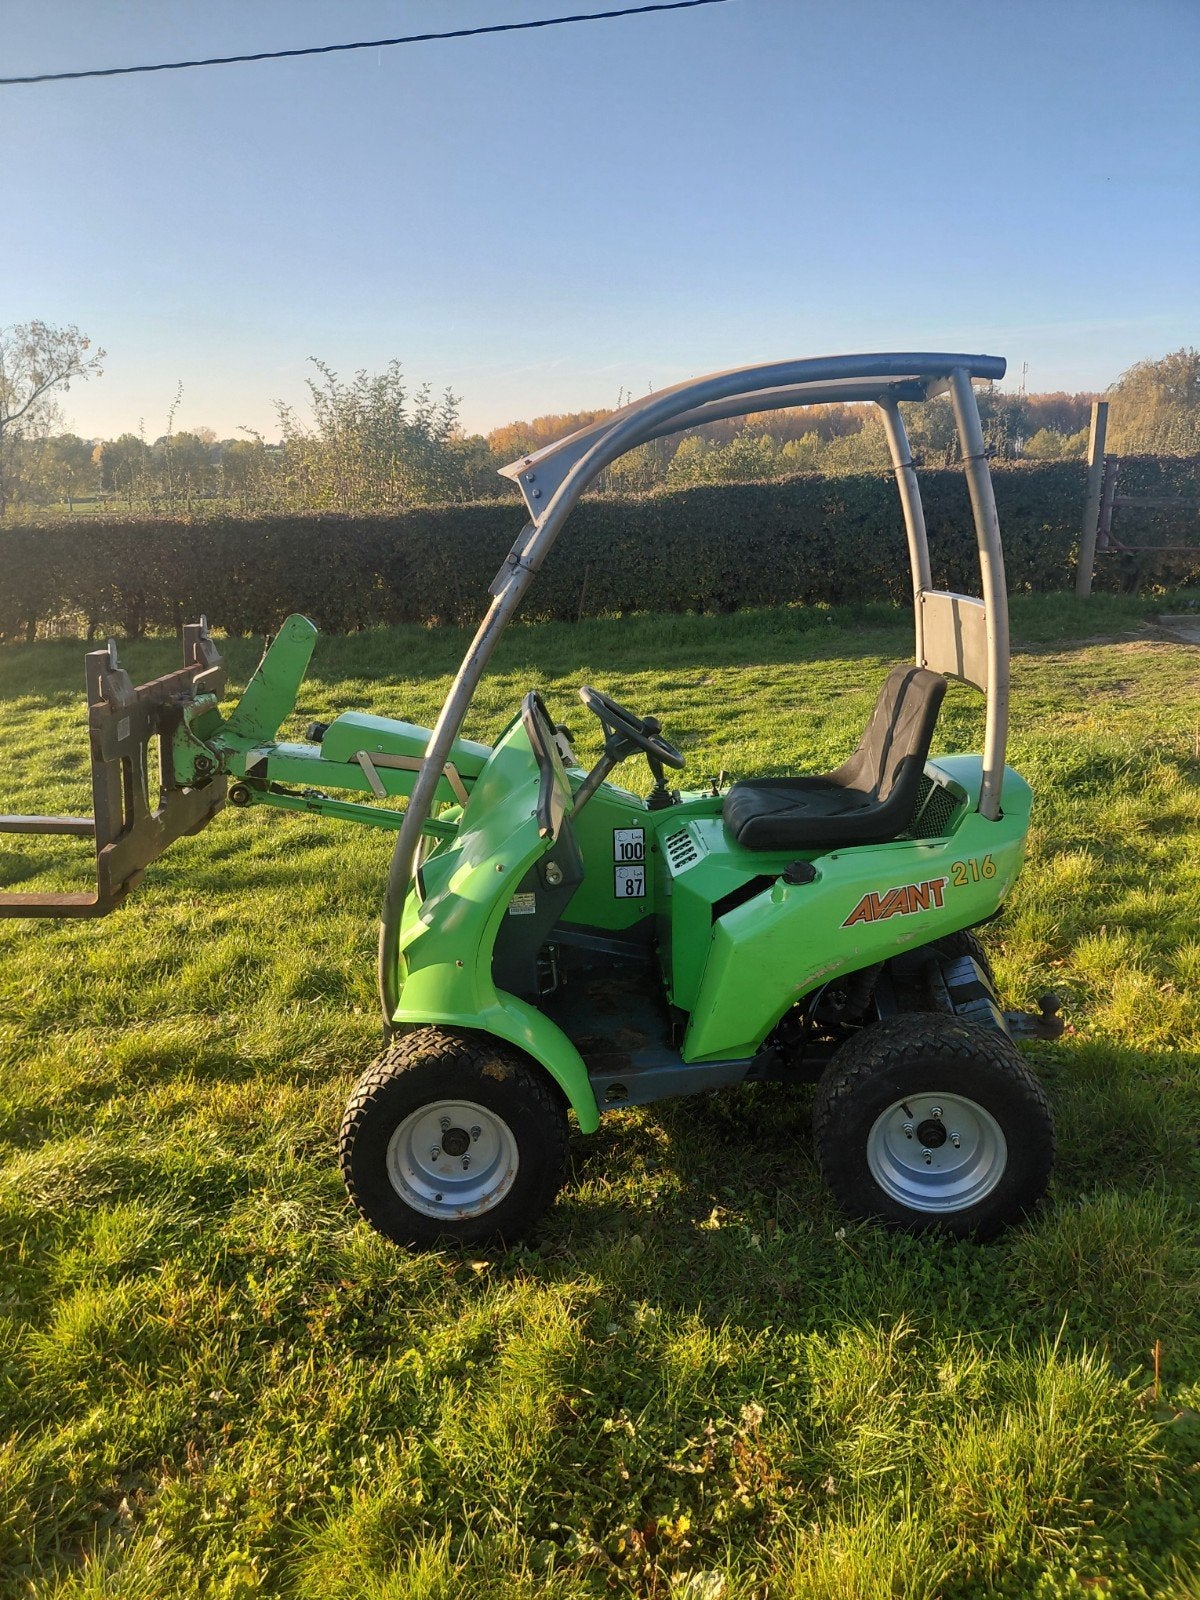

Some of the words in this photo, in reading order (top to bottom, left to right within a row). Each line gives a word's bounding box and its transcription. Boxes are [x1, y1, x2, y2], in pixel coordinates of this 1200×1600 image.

[620, 842, 643, 860] 100
[951, 854, 997, 887] 216
[625, 879, 643, 896] 87
[841, 878, 946, 927] AVANT
